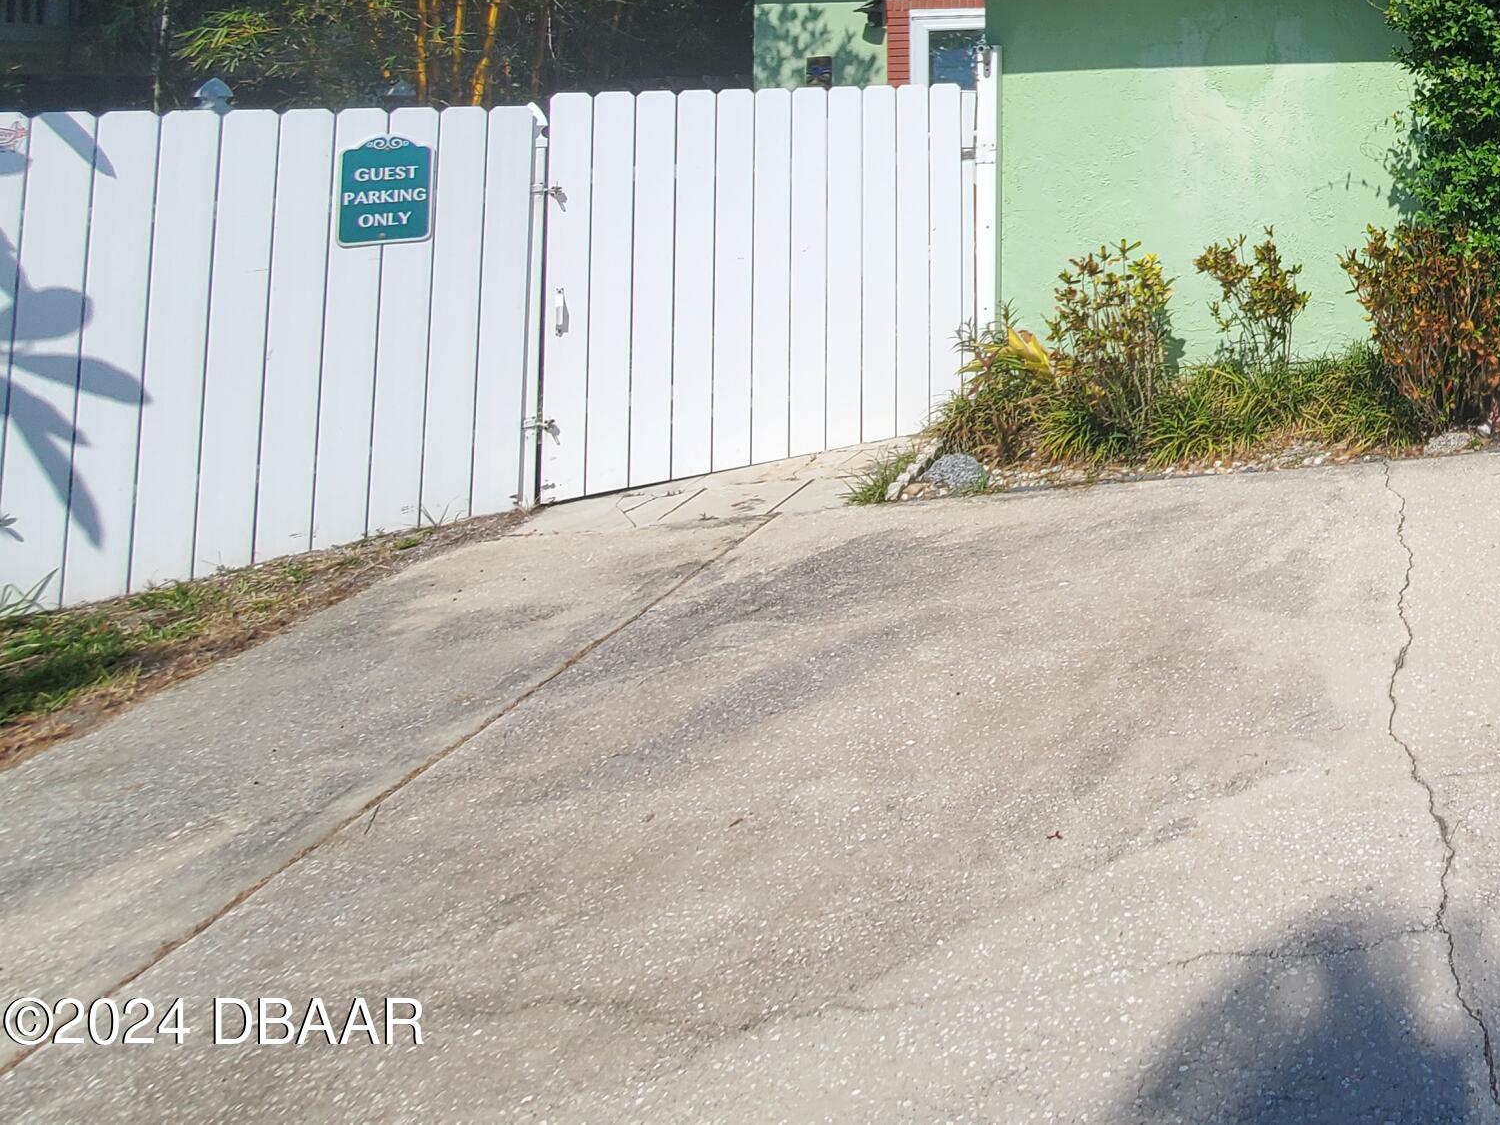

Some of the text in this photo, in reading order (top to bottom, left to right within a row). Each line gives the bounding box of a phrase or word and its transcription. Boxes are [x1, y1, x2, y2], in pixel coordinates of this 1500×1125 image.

[354, 166, 419, 182] GUEST
[343, 188, 427, 206] PARKING
[358, 211, 412, 228] ONLY
